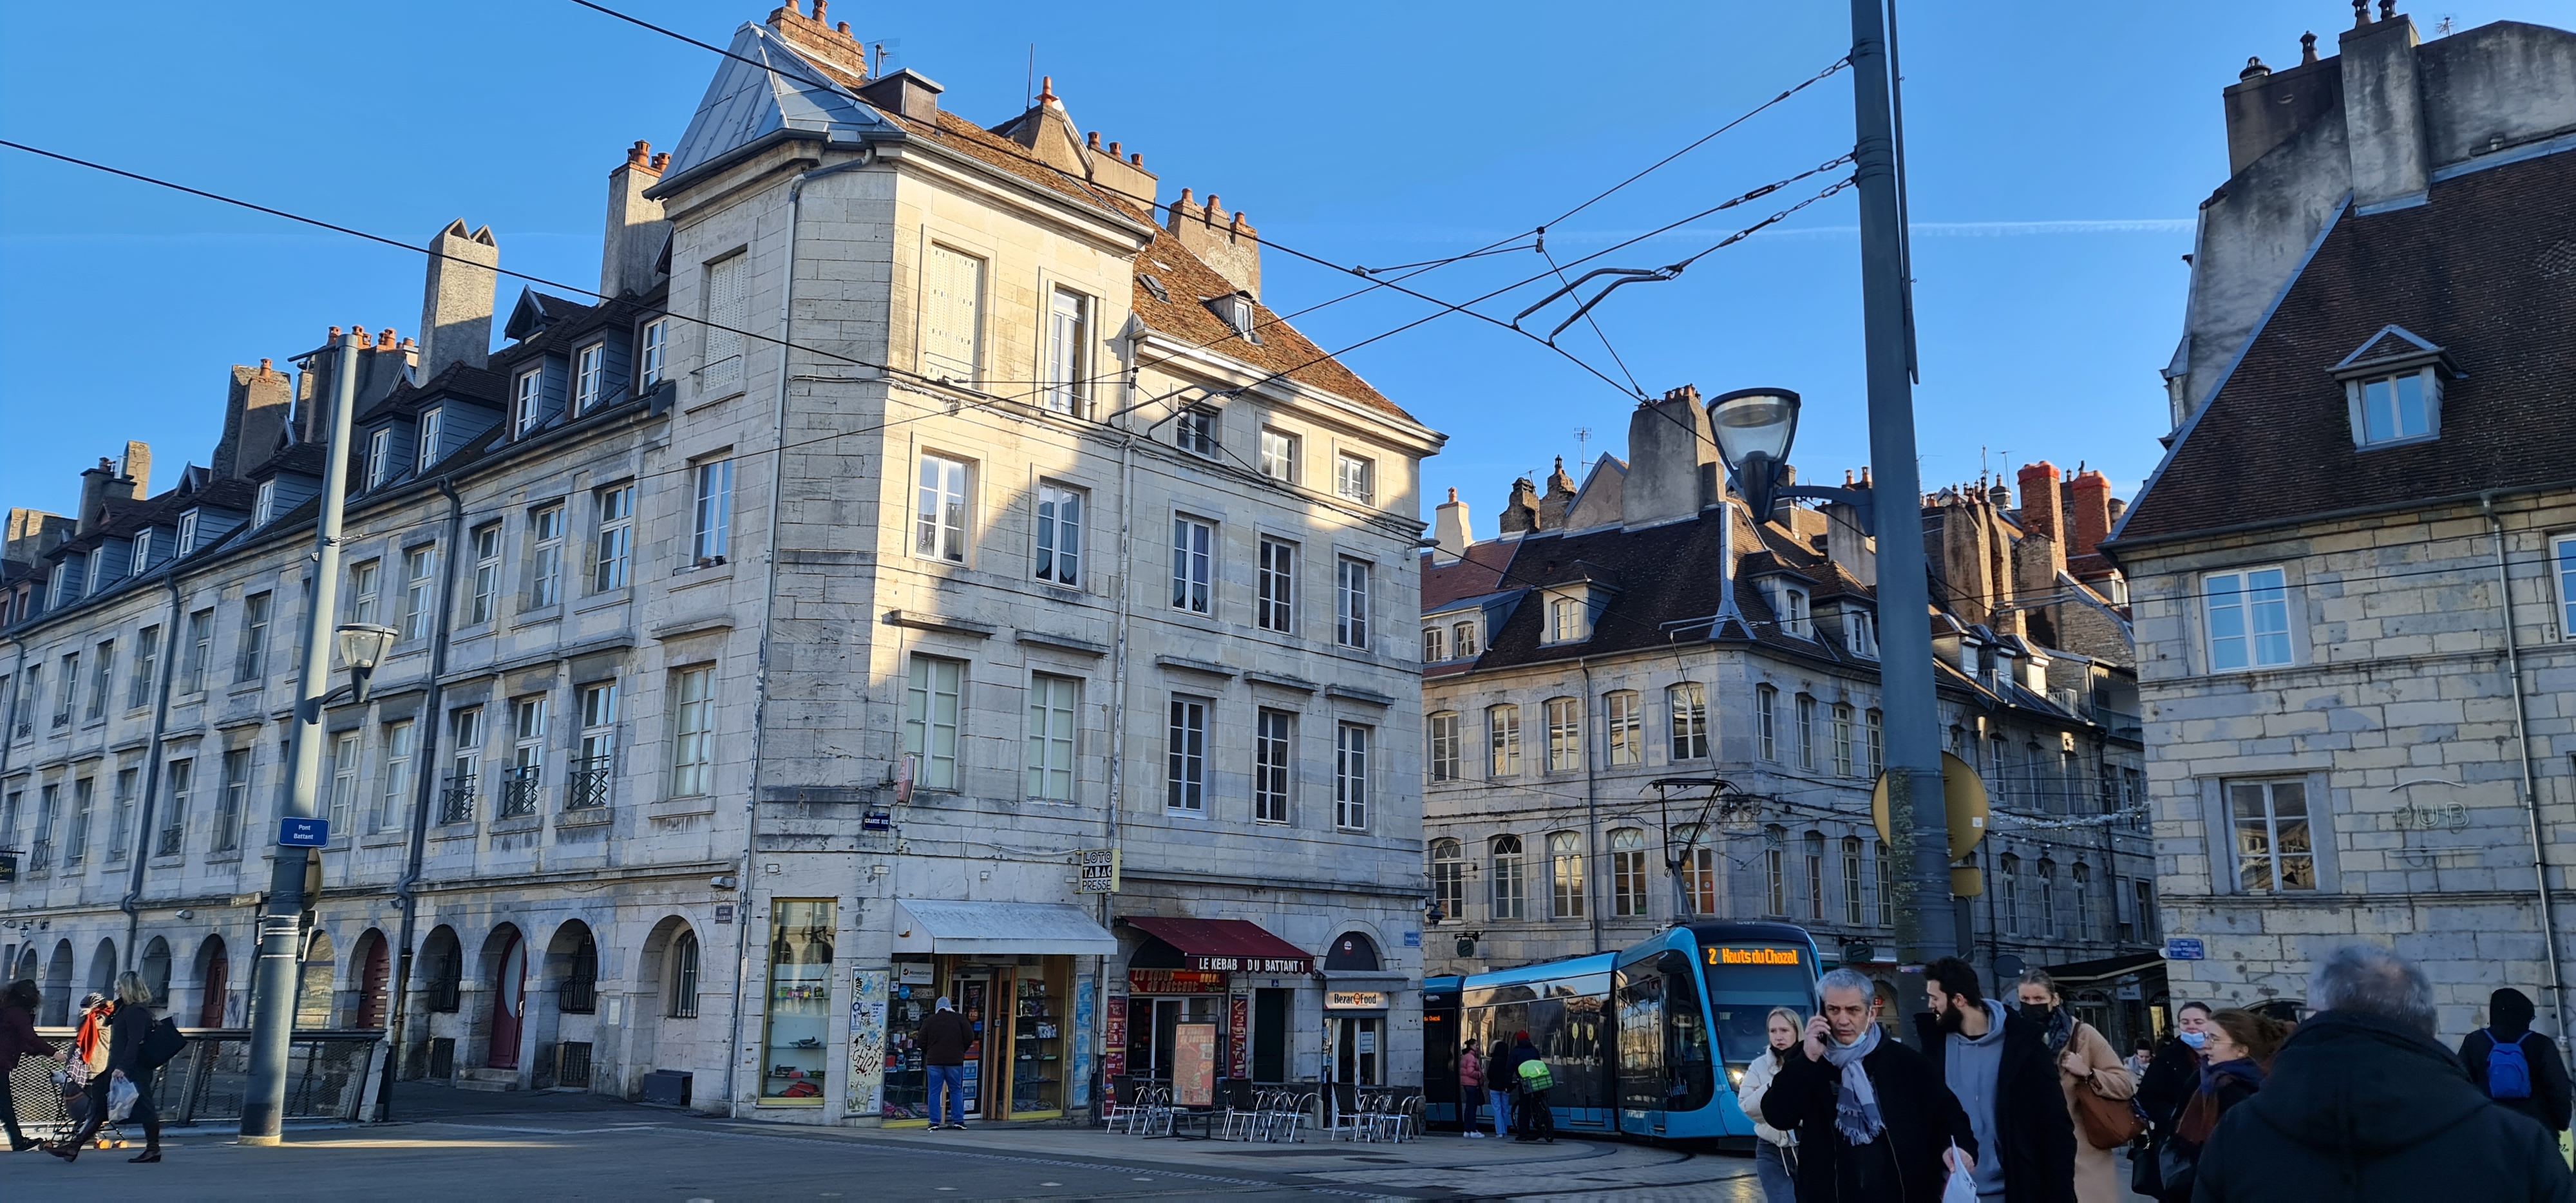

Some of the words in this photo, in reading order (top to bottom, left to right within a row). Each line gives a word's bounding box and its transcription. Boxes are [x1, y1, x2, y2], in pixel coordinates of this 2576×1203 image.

[2393, 801, 2468, 828] PUB
[1084, 851, 1113, 864] LOTO
[1083, 866, 1112, 878] TABAC
[1083, 880, 1111, 890] PRESSE
[1709, 948, 1718, 965] 2
[1722, 948, 1751, 963] Hauts
[1752, 949, 1765, 963] du
[1765, 949, 1799, 965] Chazal
[1199, 958, 1209, 970] LE
[1211, 958, 1238, 971] KEBAB
[1247, 959, 1260, 971] DU
[1265, 960, 1298, 972] BATTANT
[1300, 961, 1304, 972] 1
[1334, 994, 1354, 1004] Bezac
[1360, 994, 1376, 1004] Food
